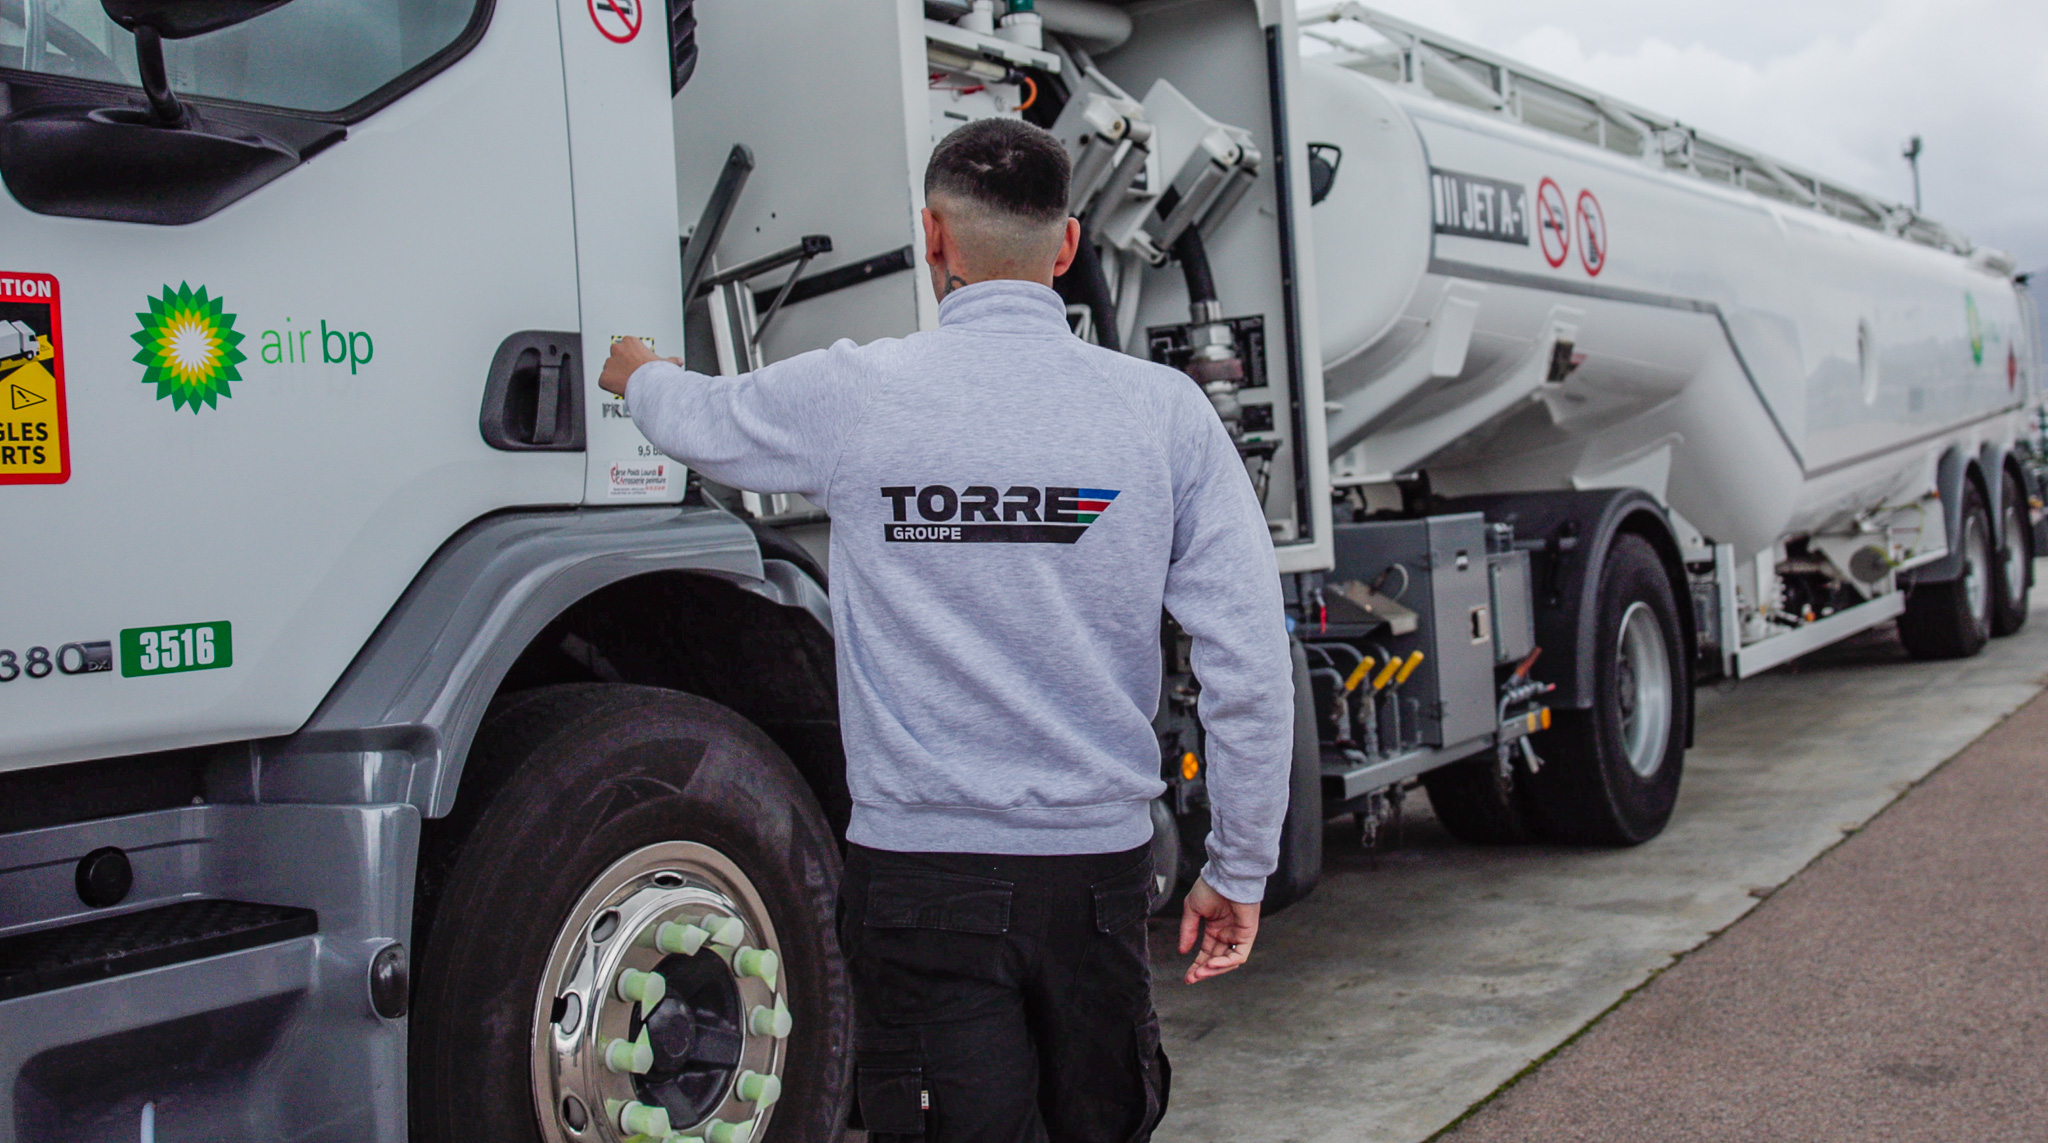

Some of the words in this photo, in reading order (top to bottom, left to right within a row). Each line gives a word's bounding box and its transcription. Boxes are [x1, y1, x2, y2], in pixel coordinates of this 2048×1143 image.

[1462, 182, 1495, 233] JET
[1500, 189, 1529, 238] A-1
[0, 278, 52, 298] TION
[261, 317, 311, 364] air
[320, 319, 373, 375] bp
[2, 446, 46, 465] RTS
[638, 445, 651, 457] 9,5
[627, 468, 640, 476] Poids
[641, 468, 656, 476] Lourds
[645, 477, 667, 485] peinture
[880, 485, 1121, 524] TORRE
[893, 526, 961, 540] GROUPE
[139, 626, 215, 670] 3516
[0, 641, 85, 683] 380
